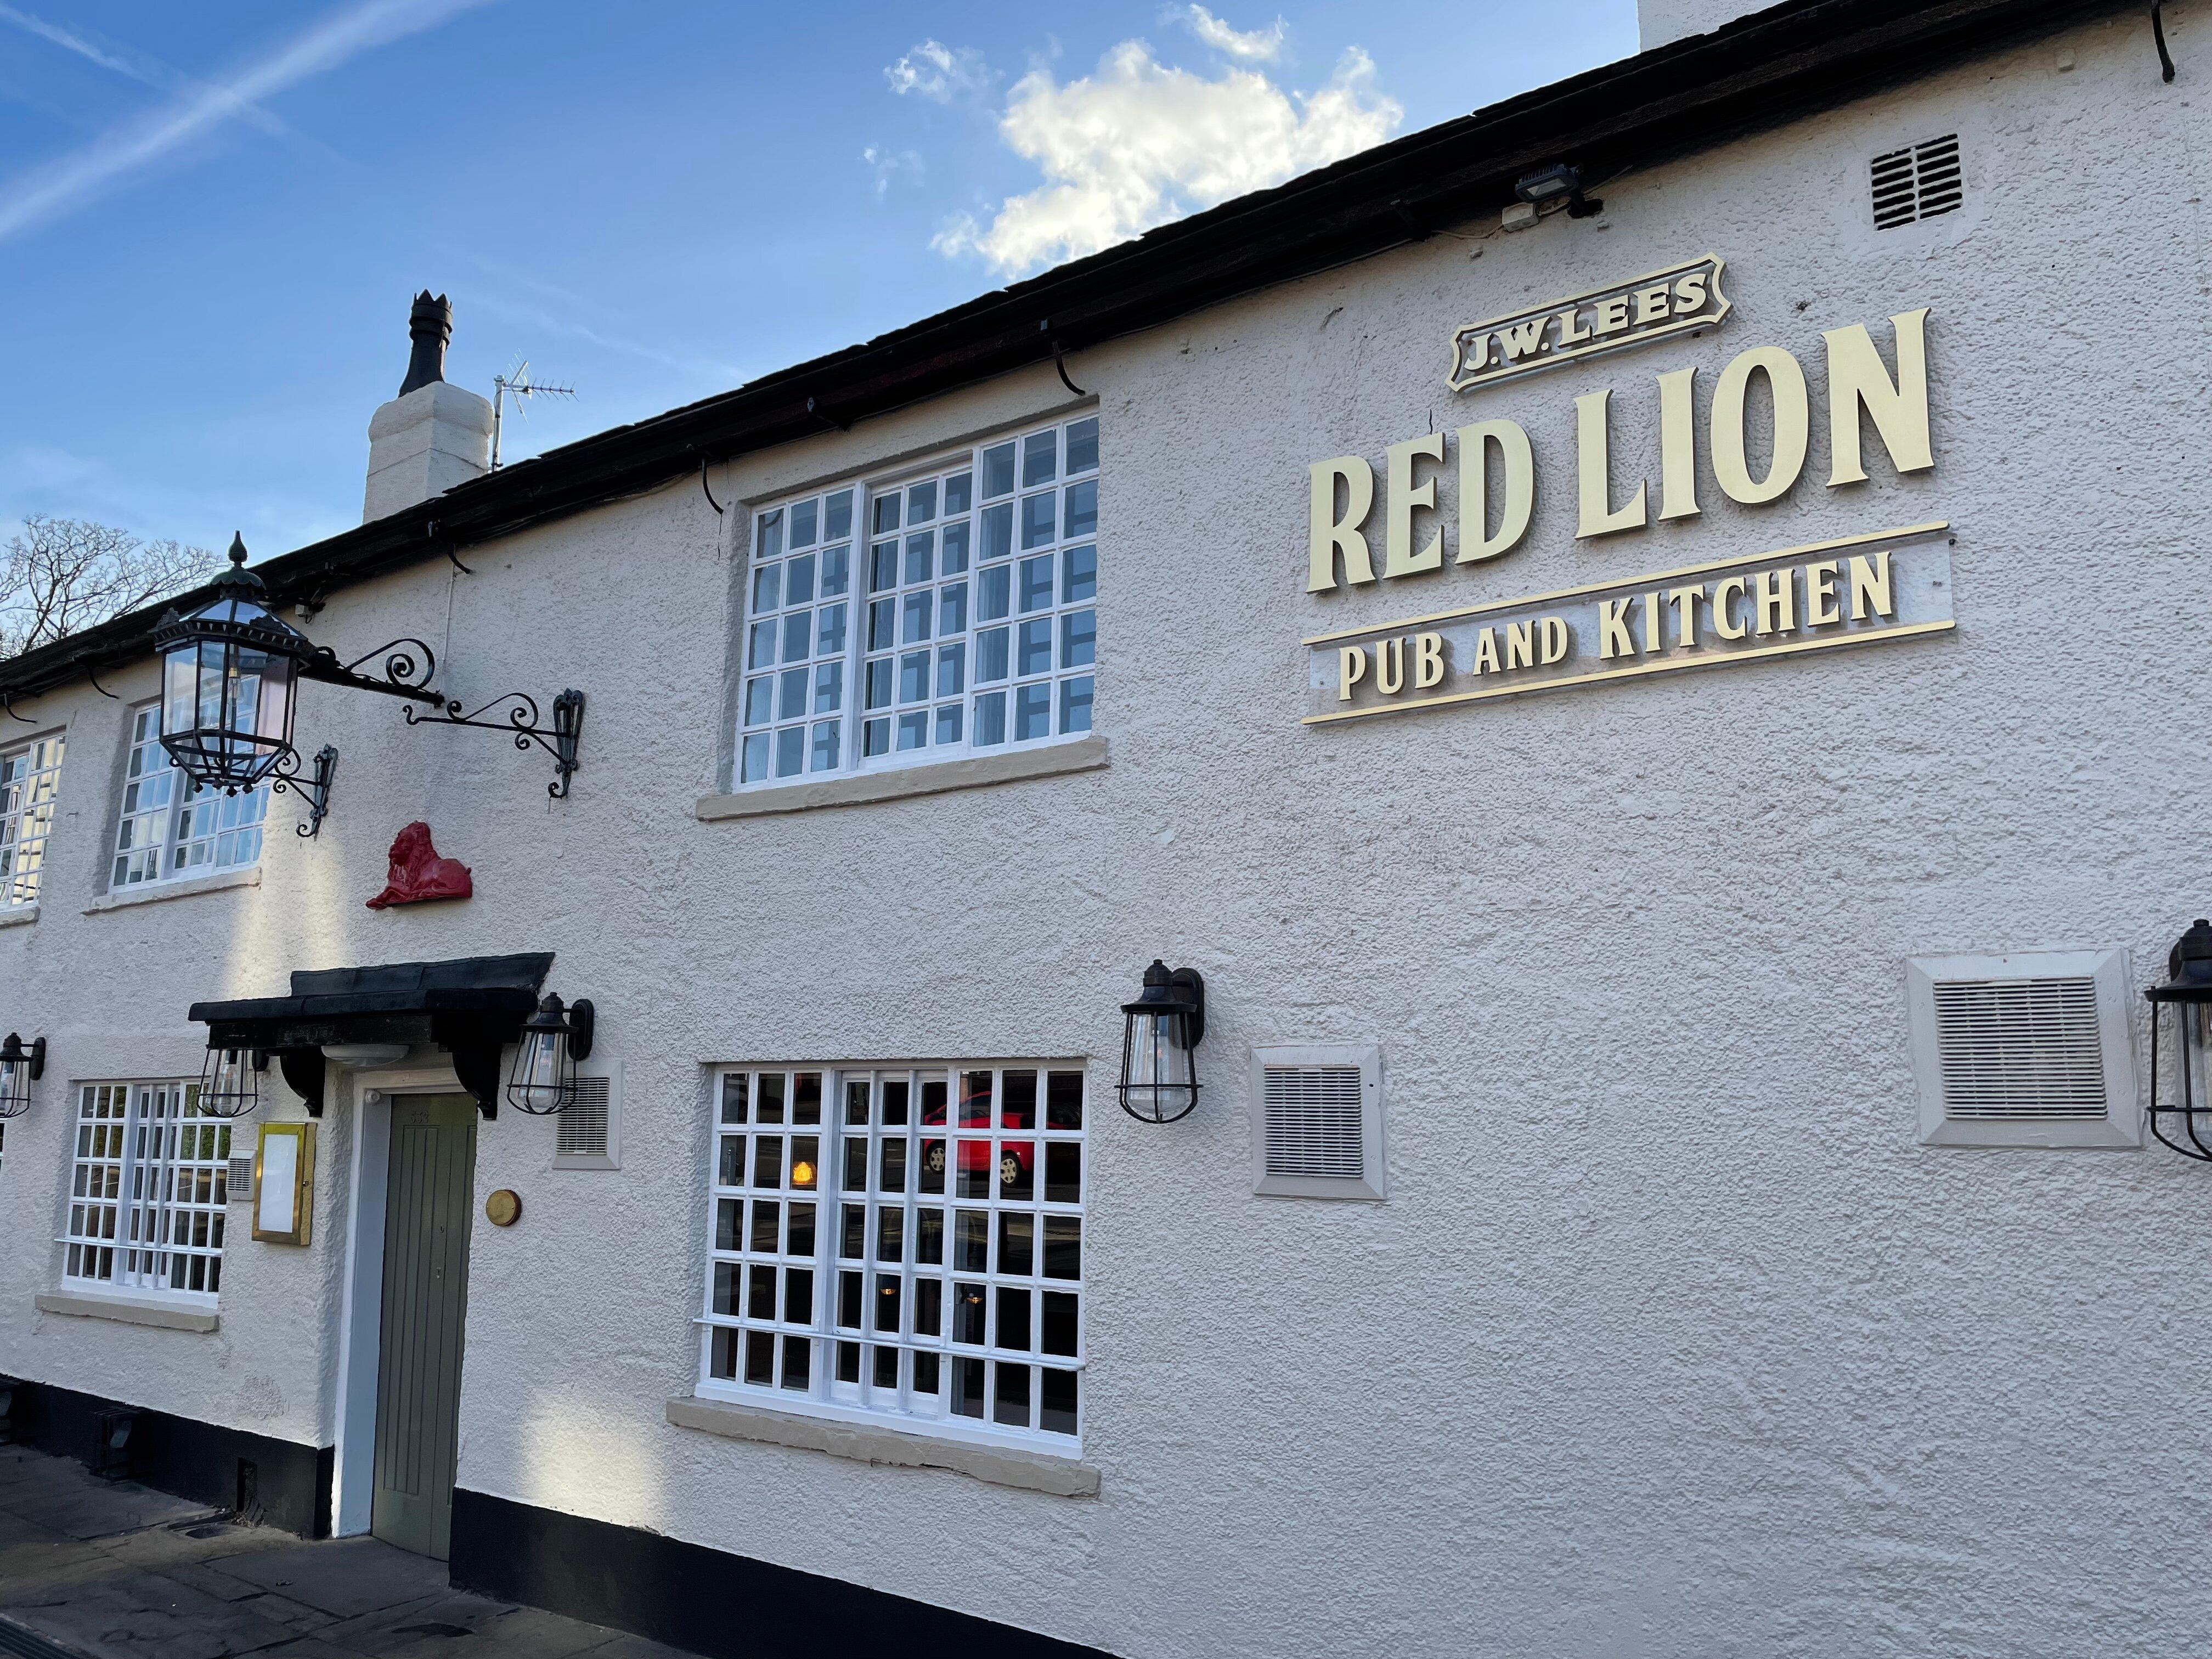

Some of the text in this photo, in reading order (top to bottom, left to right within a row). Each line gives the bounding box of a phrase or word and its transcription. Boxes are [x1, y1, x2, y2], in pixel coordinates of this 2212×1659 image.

[1305, 307, 1934, 594] RED LION
[1338, 551, 1893, 701] PUB AND KITCHEN
